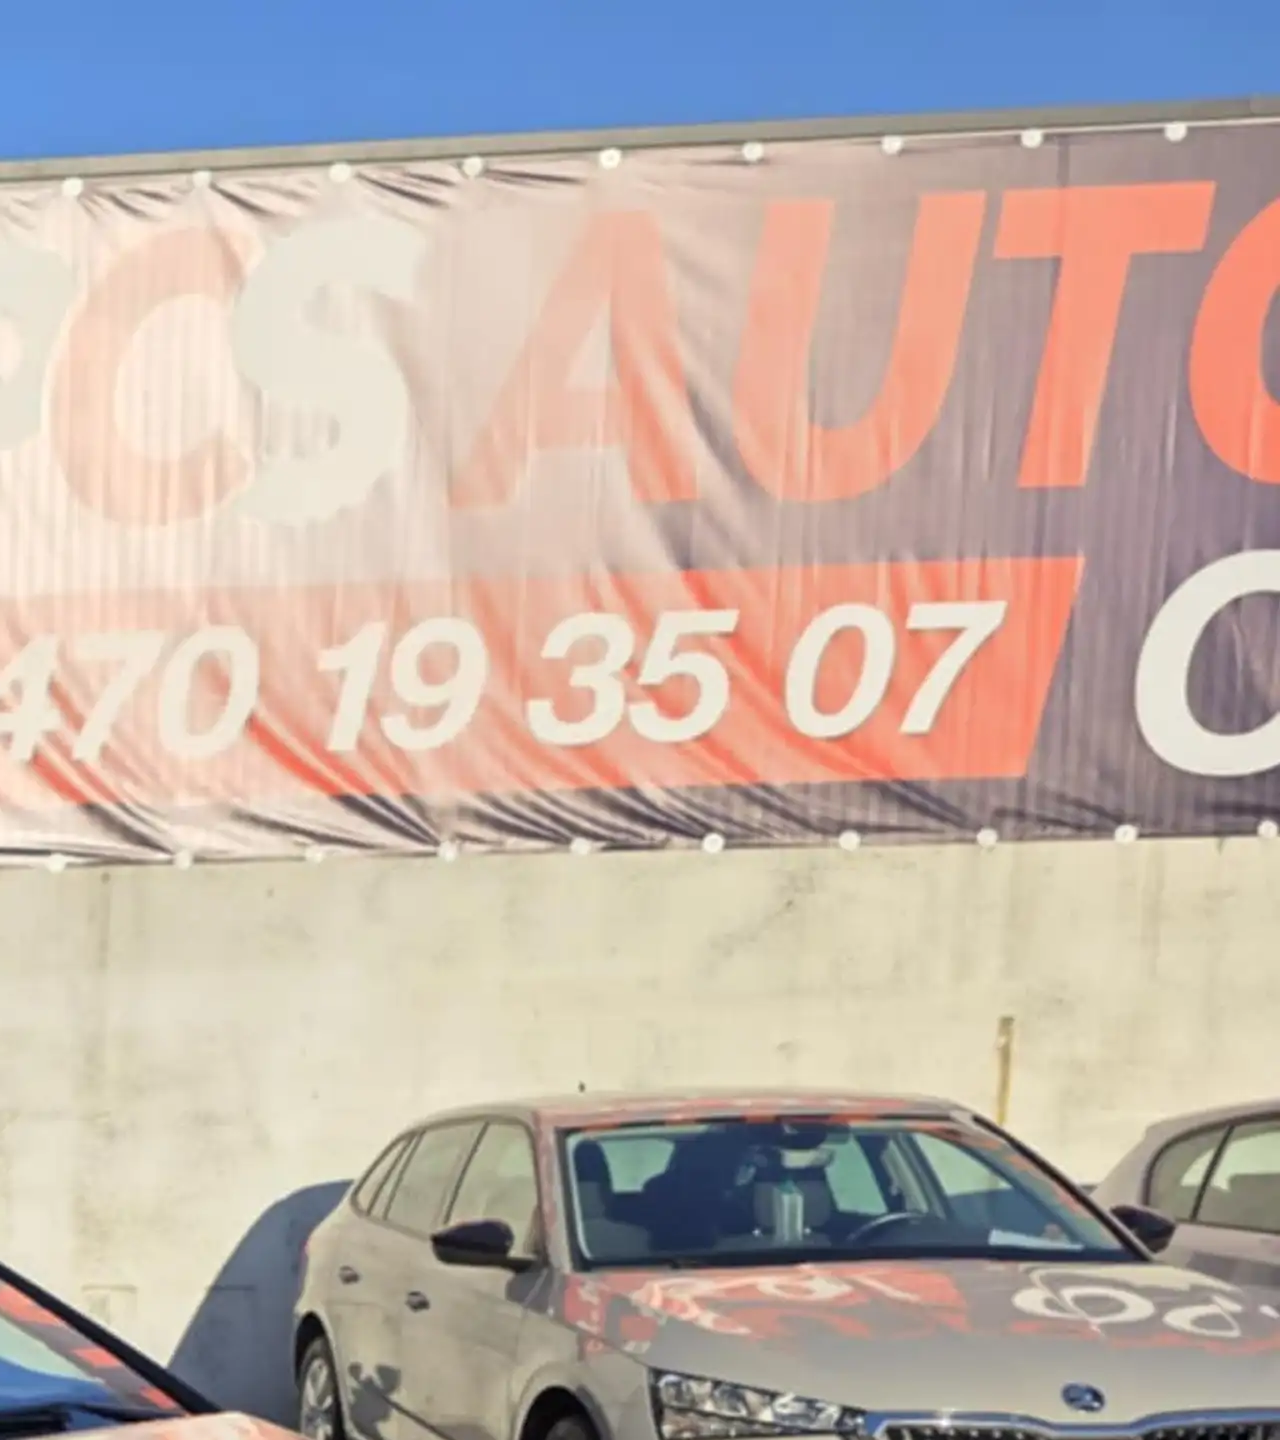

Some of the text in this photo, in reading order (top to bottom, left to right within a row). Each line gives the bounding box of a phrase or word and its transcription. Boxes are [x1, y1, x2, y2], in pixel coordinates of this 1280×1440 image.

[315, 619, 487, 751] 19
[527, 608, 740, 745] 35
[783, 600, 1007, 738] 07
